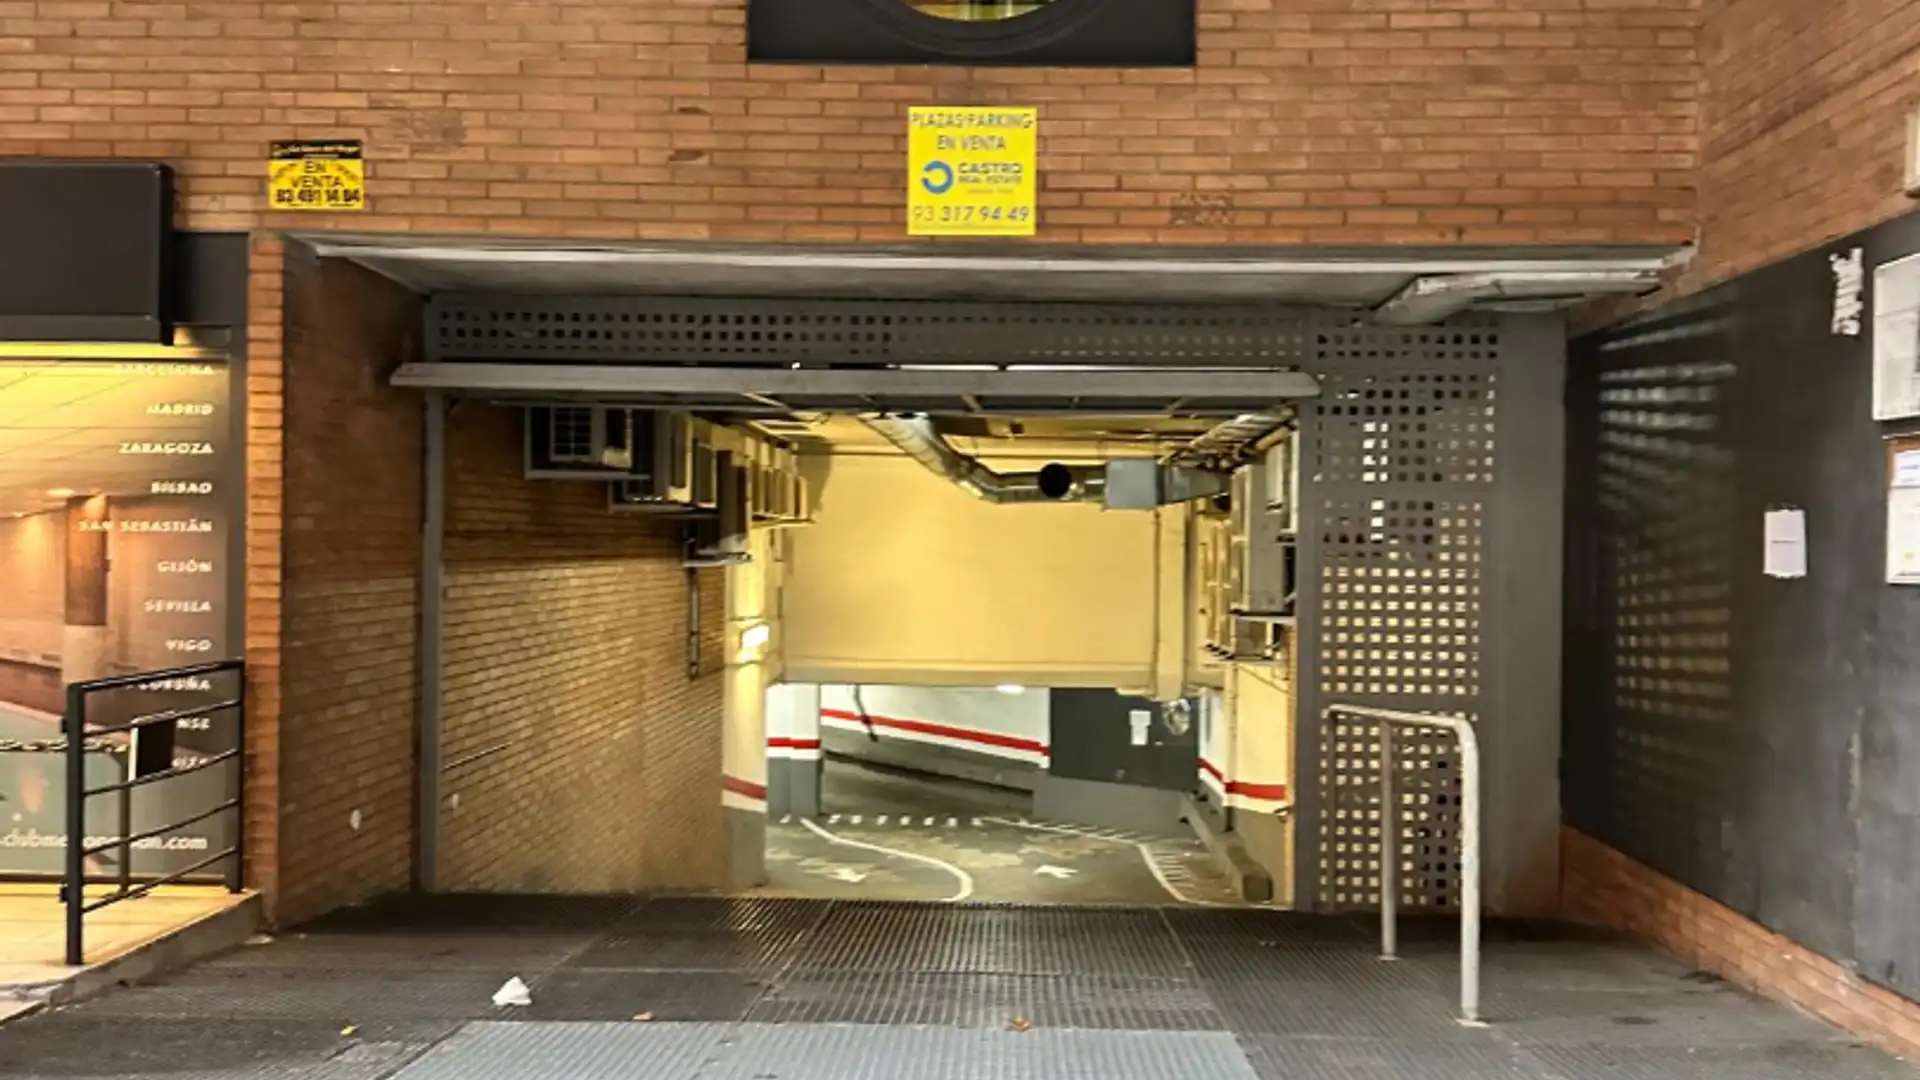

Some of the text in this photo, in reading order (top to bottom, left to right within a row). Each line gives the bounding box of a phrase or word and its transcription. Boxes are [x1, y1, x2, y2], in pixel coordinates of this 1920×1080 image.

[967, 112, 1033, 128] PARKING
[938, 135, 1005, 150] EN VENTA
[304, 161, 326, 173] EN
[958, 162, 1021, 173] CASTRO
[291, 175, 345, 187] VENTA
[941, 206, 974, 221] 317
[979, 206, 1003, 221] 94
[1007, 206, 1029, 221] 49
[145, 403, 214, 415] MADRID
[119, 442, 214, 455] ZARAGOZA
[151, 482, 213, 494] BILBAO
[157, 558, 213, 573] GIJÓN
[144, 600, 212, 612] SEVILLA
[165, 639, 212, 652] VIGO
